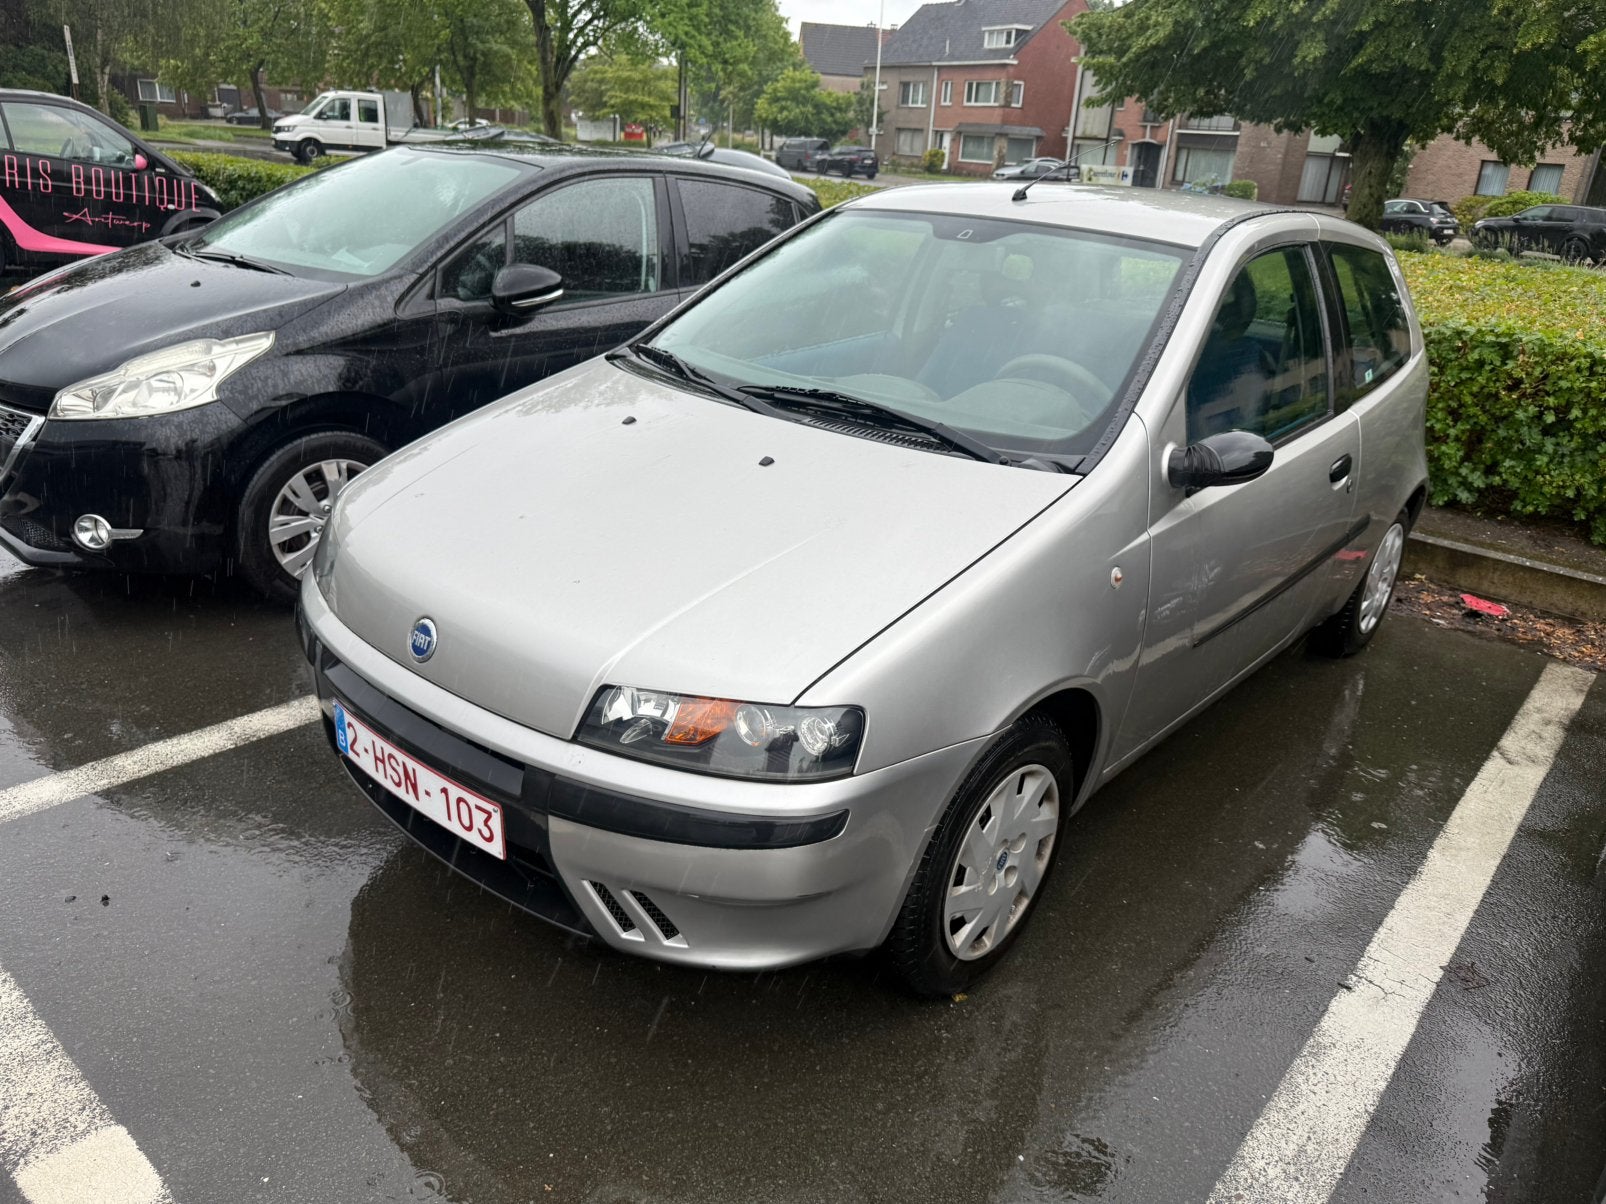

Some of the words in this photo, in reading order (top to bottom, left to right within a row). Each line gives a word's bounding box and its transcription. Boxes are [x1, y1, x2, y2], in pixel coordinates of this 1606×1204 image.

[71, 164, 201, 212] BOUTIQUE
[411, 630, 432, 650] FIAT
[338, 729, 346, 748] B
[347, 722, 495, 843] 2-HSN-103
